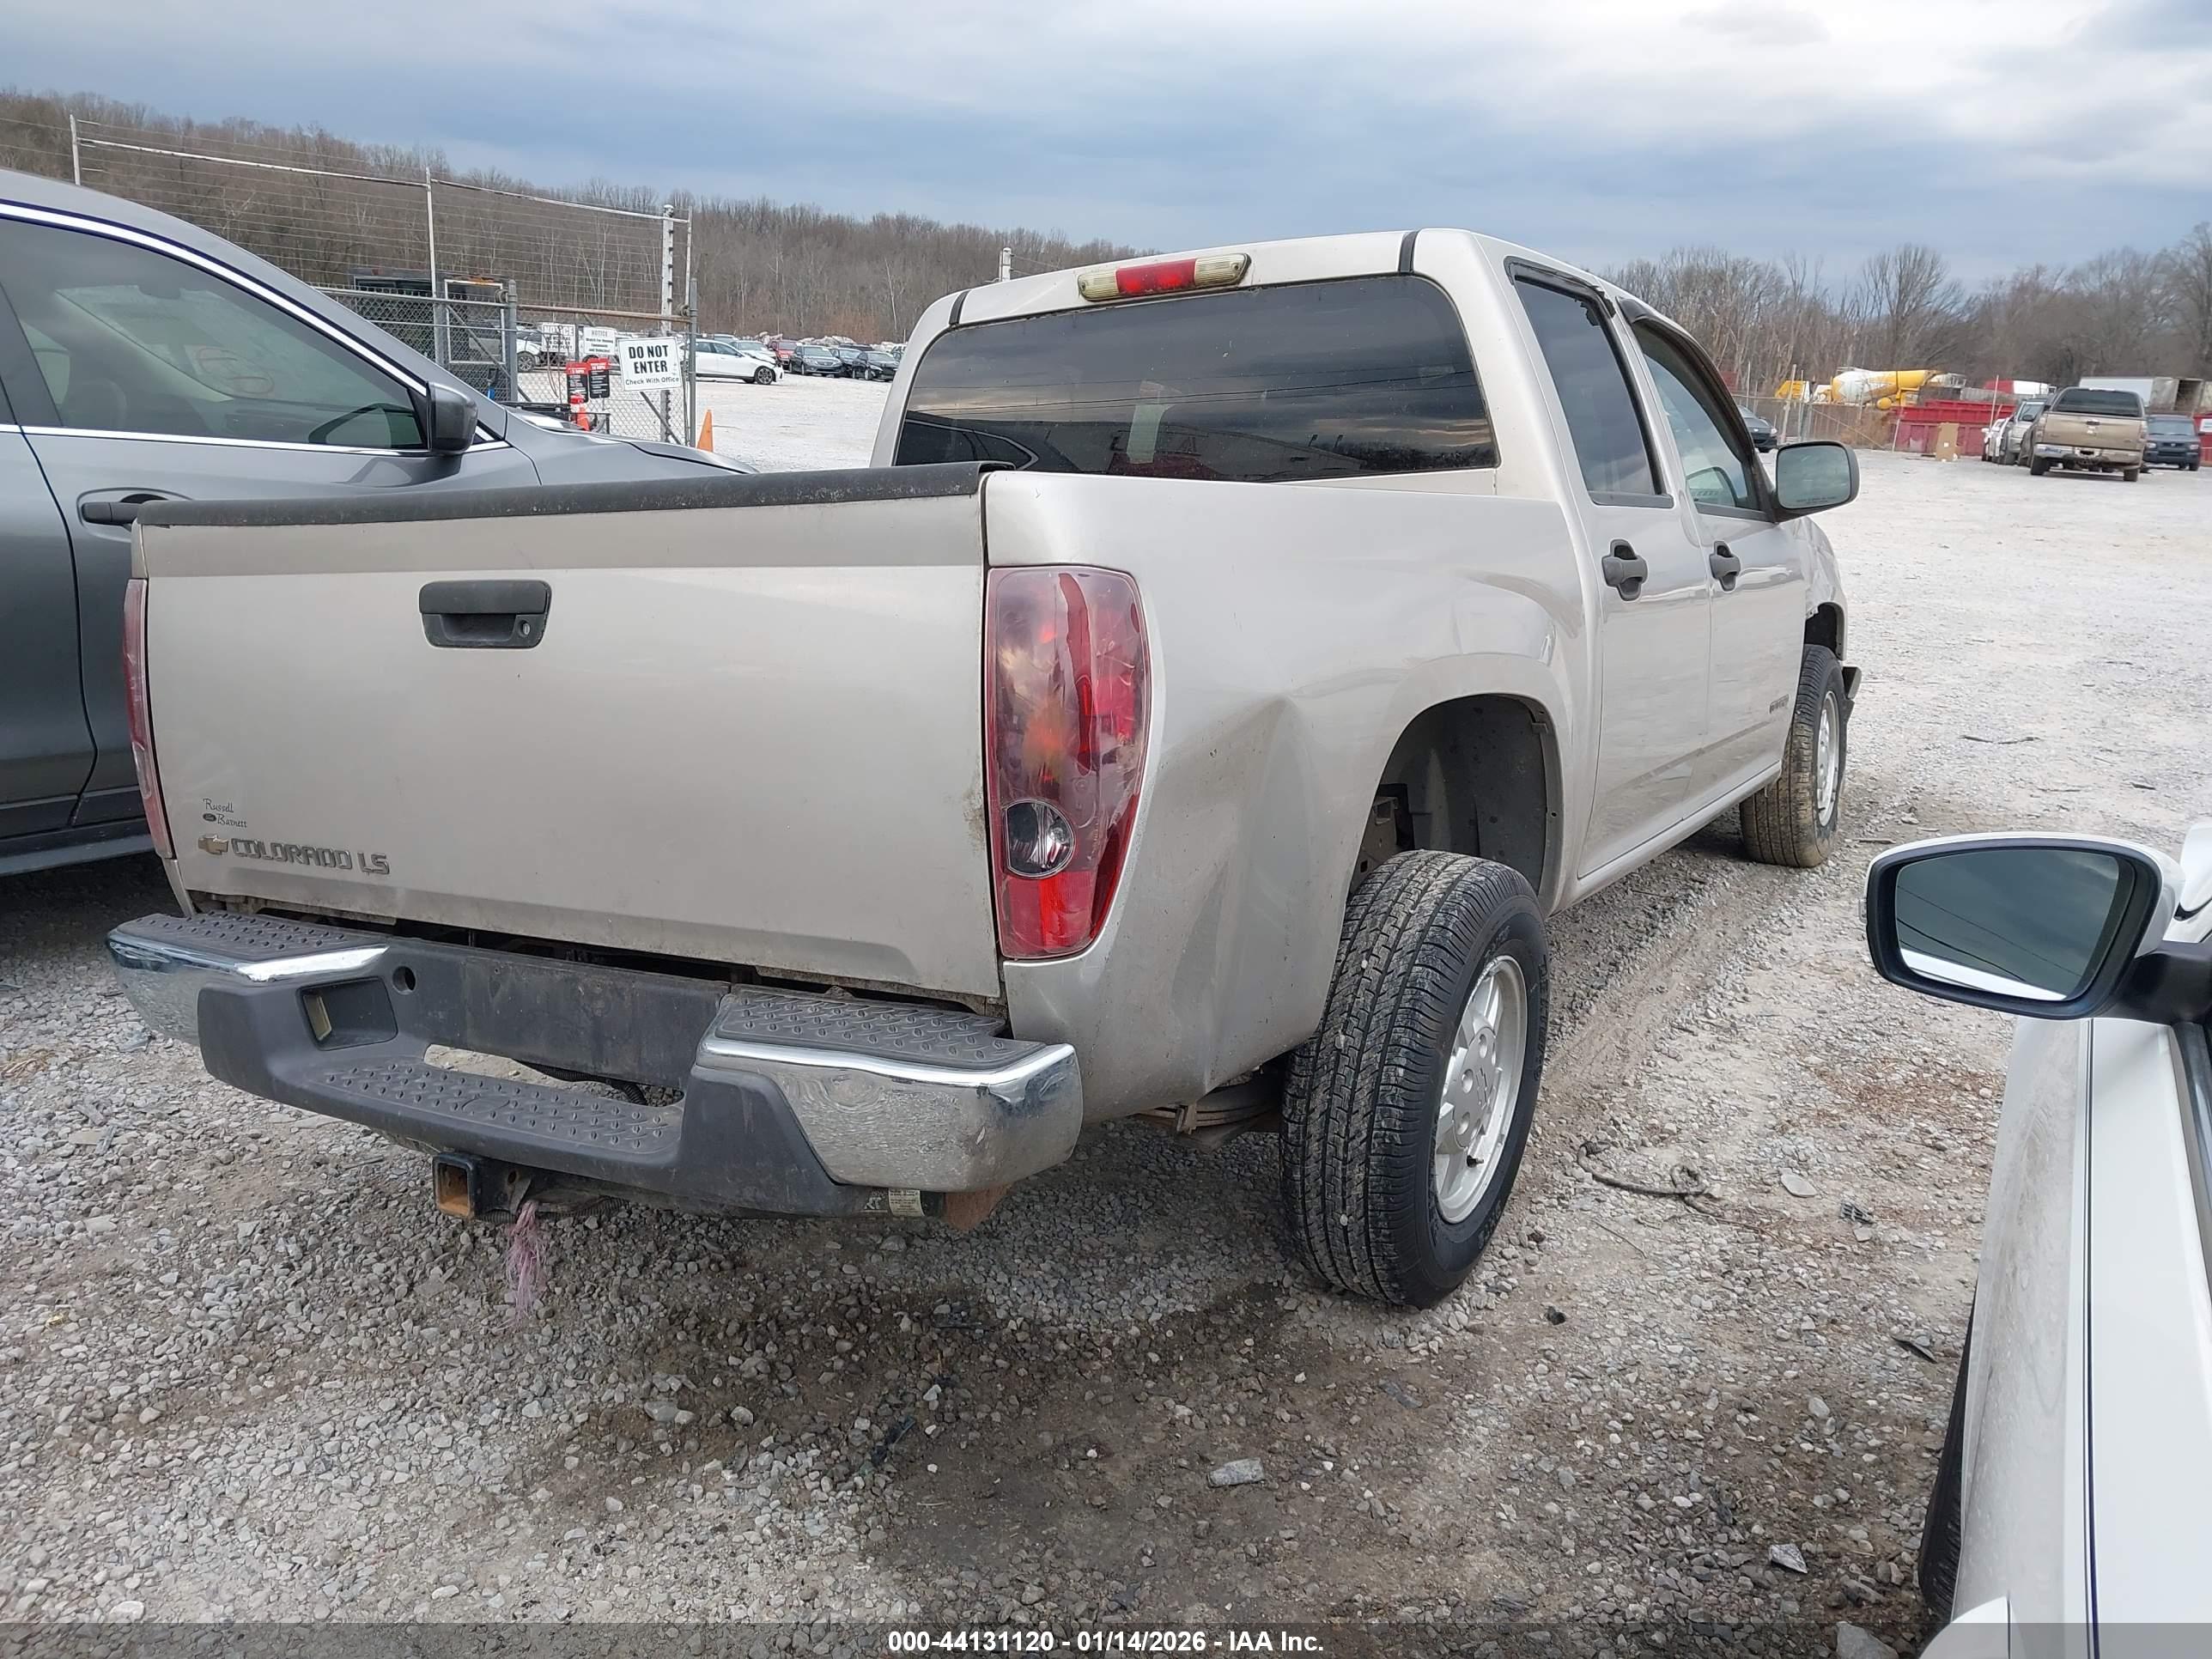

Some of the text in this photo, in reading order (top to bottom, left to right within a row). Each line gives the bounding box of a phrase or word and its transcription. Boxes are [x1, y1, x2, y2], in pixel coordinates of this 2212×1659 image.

[629, 345, 668, 359] DO NOT
[634, 361, 668, 374] ENTER
[231, 838, 390, 875] COLORADO LS
